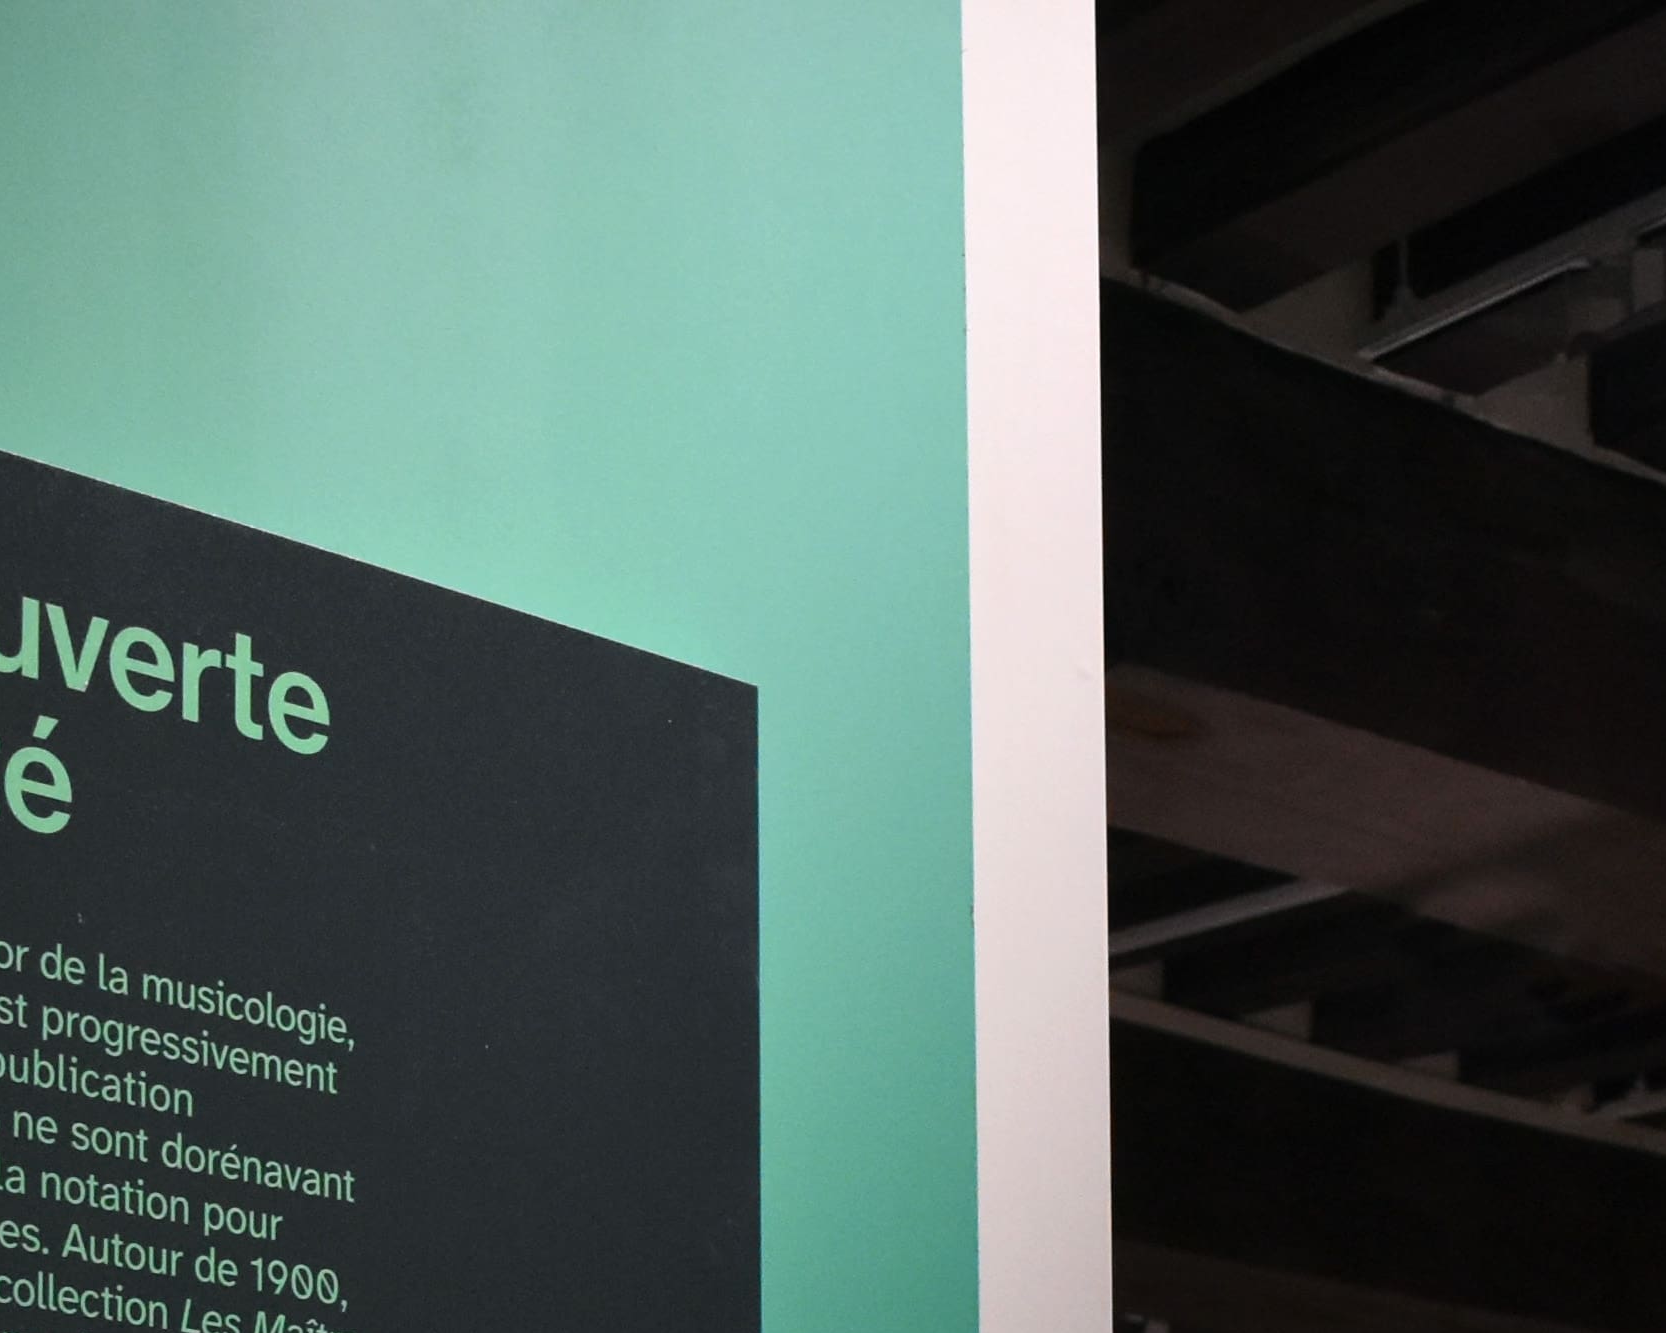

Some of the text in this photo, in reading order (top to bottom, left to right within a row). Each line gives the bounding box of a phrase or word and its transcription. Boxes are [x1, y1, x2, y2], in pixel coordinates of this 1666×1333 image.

[38, 941, 87, 987] de
[97, 951, 130, 997] la
[141, 972, 356, 1053] musicologie,
[40, 1004, 339, 1096] progressivement
[12, 1109, 60, 1146] ne
[70, 1121, 150, 1164] sont
[160, 1130, 357, 1204] dorénavant
